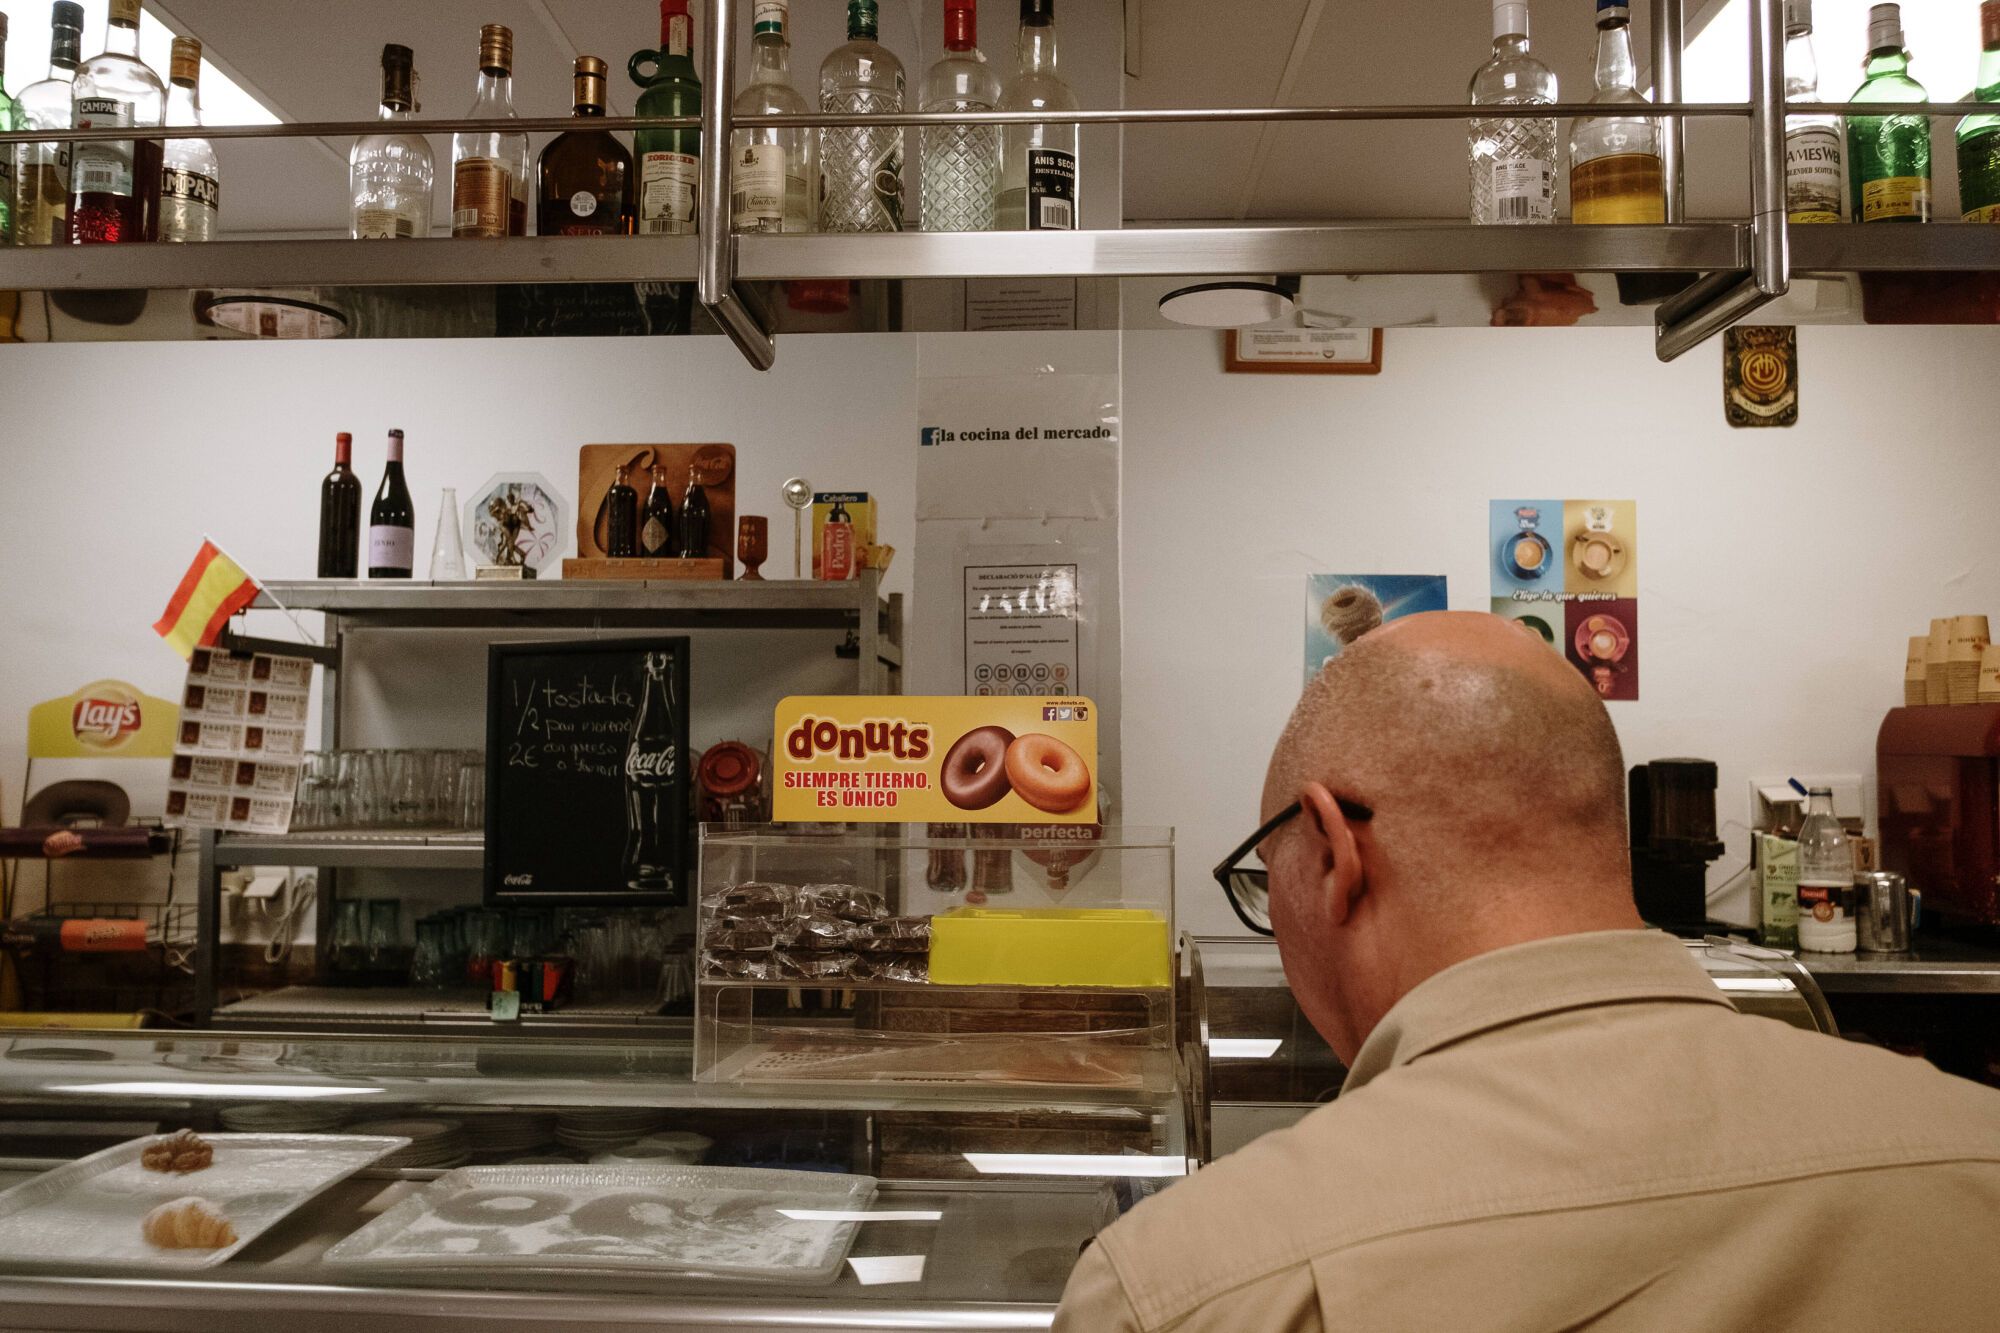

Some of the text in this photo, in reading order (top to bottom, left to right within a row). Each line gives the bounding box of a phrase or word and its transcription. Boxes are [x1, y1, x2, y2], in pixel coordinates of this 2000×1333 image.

[1034, 156, 1075, 170] ANIS SECO
[1787, 147, 1822, 162] AMES
[941, 426, 1111, 442] la cocina del mercado
[822, 494, 858, 502] Caballero
[832, 528, 846, 568] Pedro
[1512, 589, 1616, 603] Elige la que quieres
[542, 674, 635, 709] tostada
[76, 697, 138, 737] Lay's
[545, 719, 575, 741] pan
[788, 718, 929, 760] donuts
[508, 742, 540, 768] 2€
[784, 772, 932, 790] SIEMPRE TIERNO,
[817, 788, 898, 807] ES ÚNICO
[1020, 825, 1093, 840] perfecta
